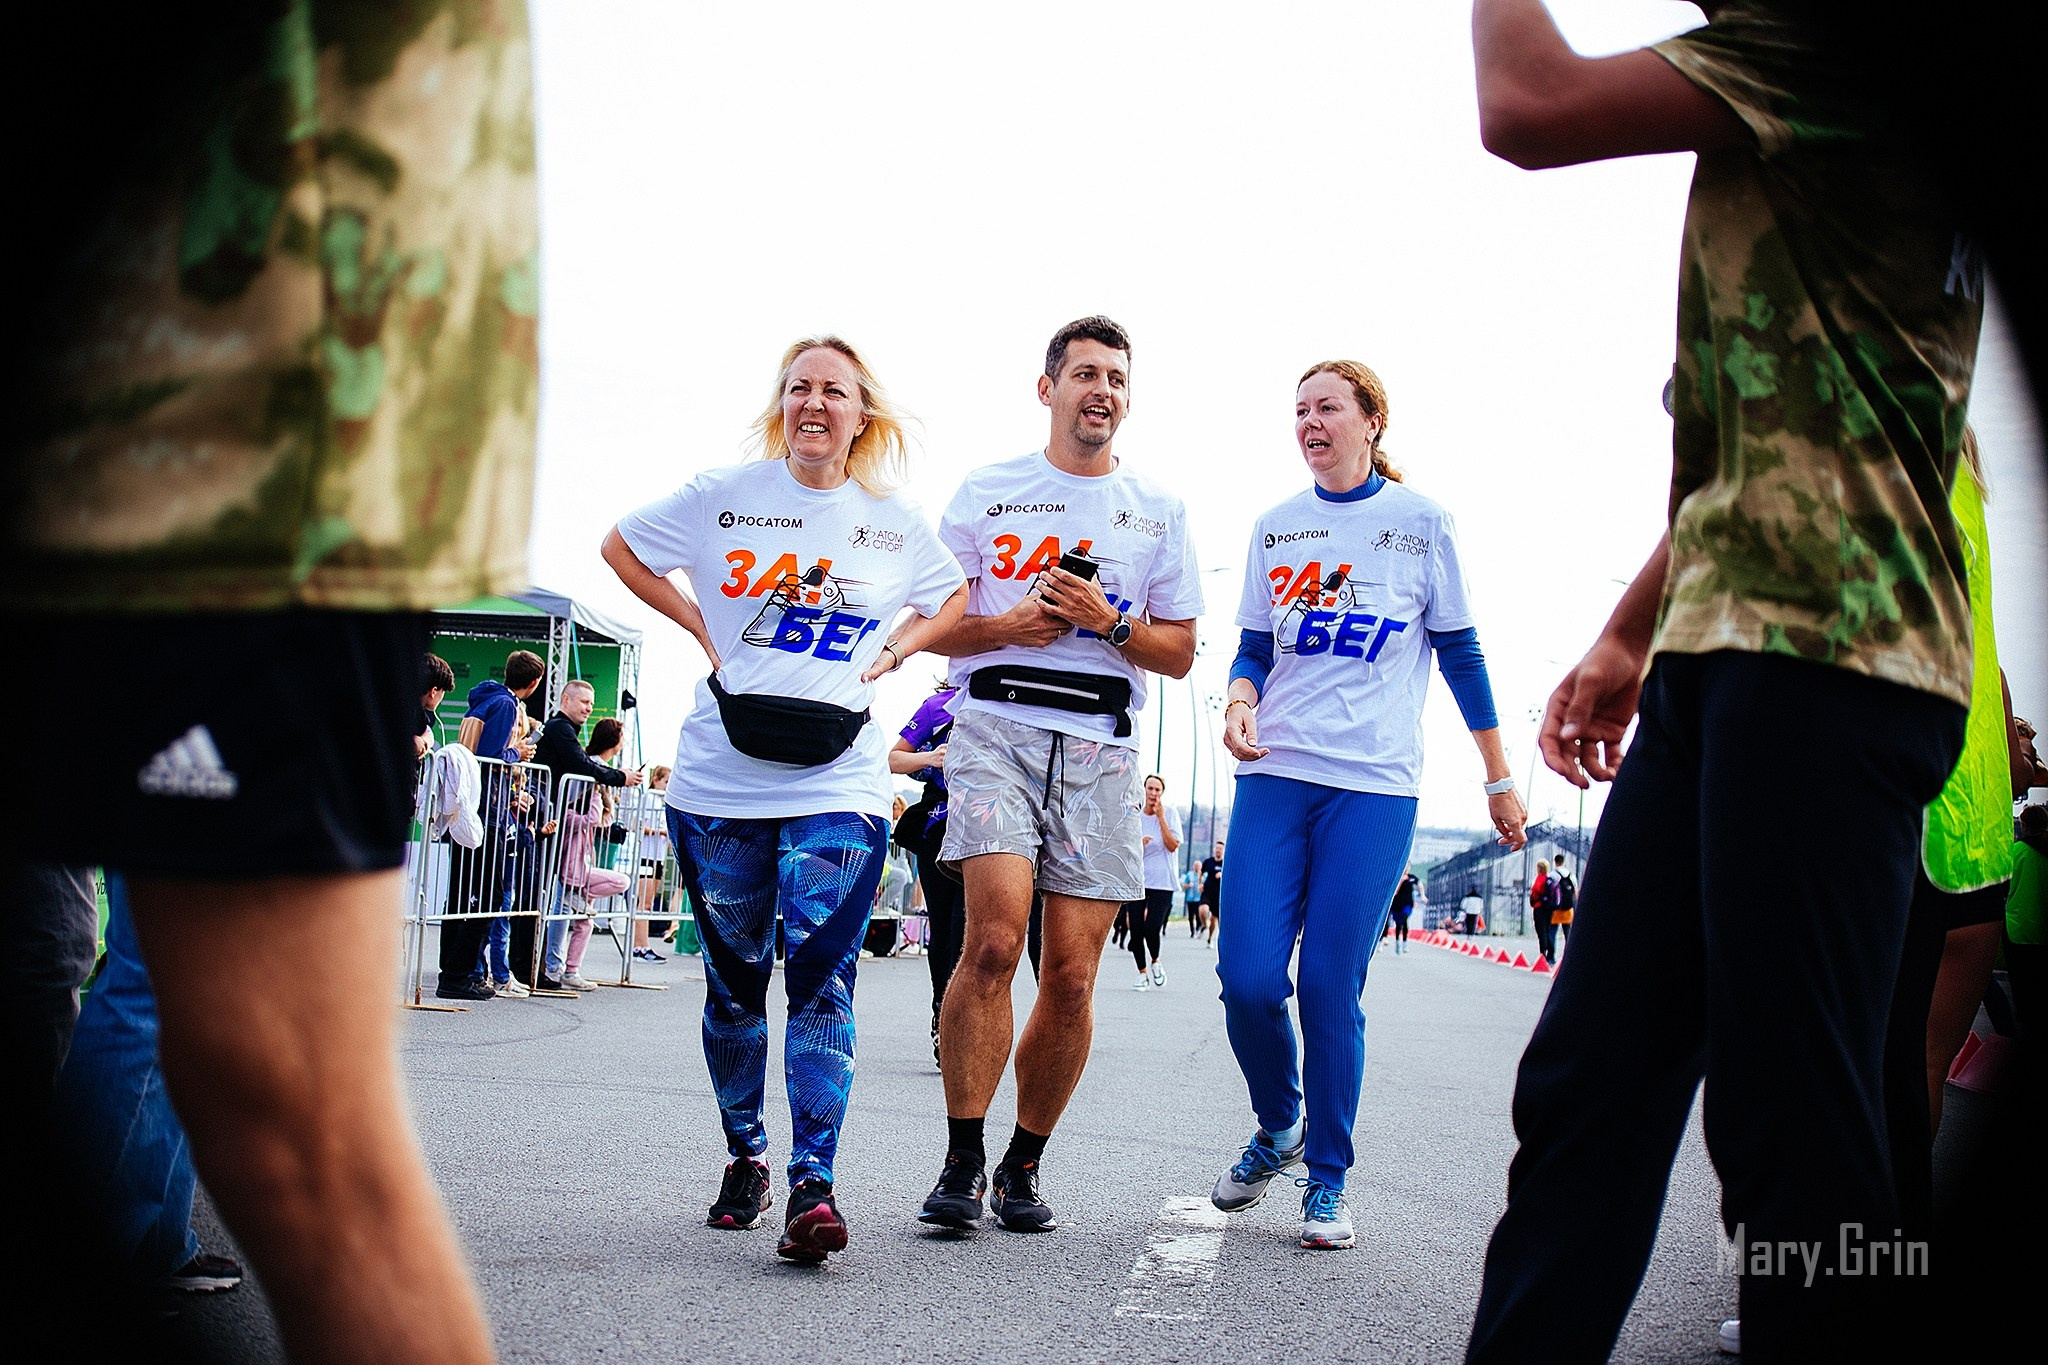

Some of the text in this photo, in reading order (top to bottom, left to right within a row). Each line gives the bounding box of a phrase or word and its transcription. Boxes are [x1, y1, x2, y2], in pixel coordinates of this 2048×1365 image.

[1005, 503, 1066, 514] РОСАТОМ
[737, 515, 803, 529] РОСАТОМ
[1138, 517, 1166, 530] АТОМ
[877, 530, 904, 543] АТОМ
[1277, 530, 1329, 545] РОСАТОМ
[1400, 534, 1429, 549] АТОМ
[872, 539, 903, 554] СПОРТ
[1395, 542, 1428, 559] СПОРТ
[769, 605, 881, 663] БЕГ
[1295, 610, 1409, 664] БЕГ
